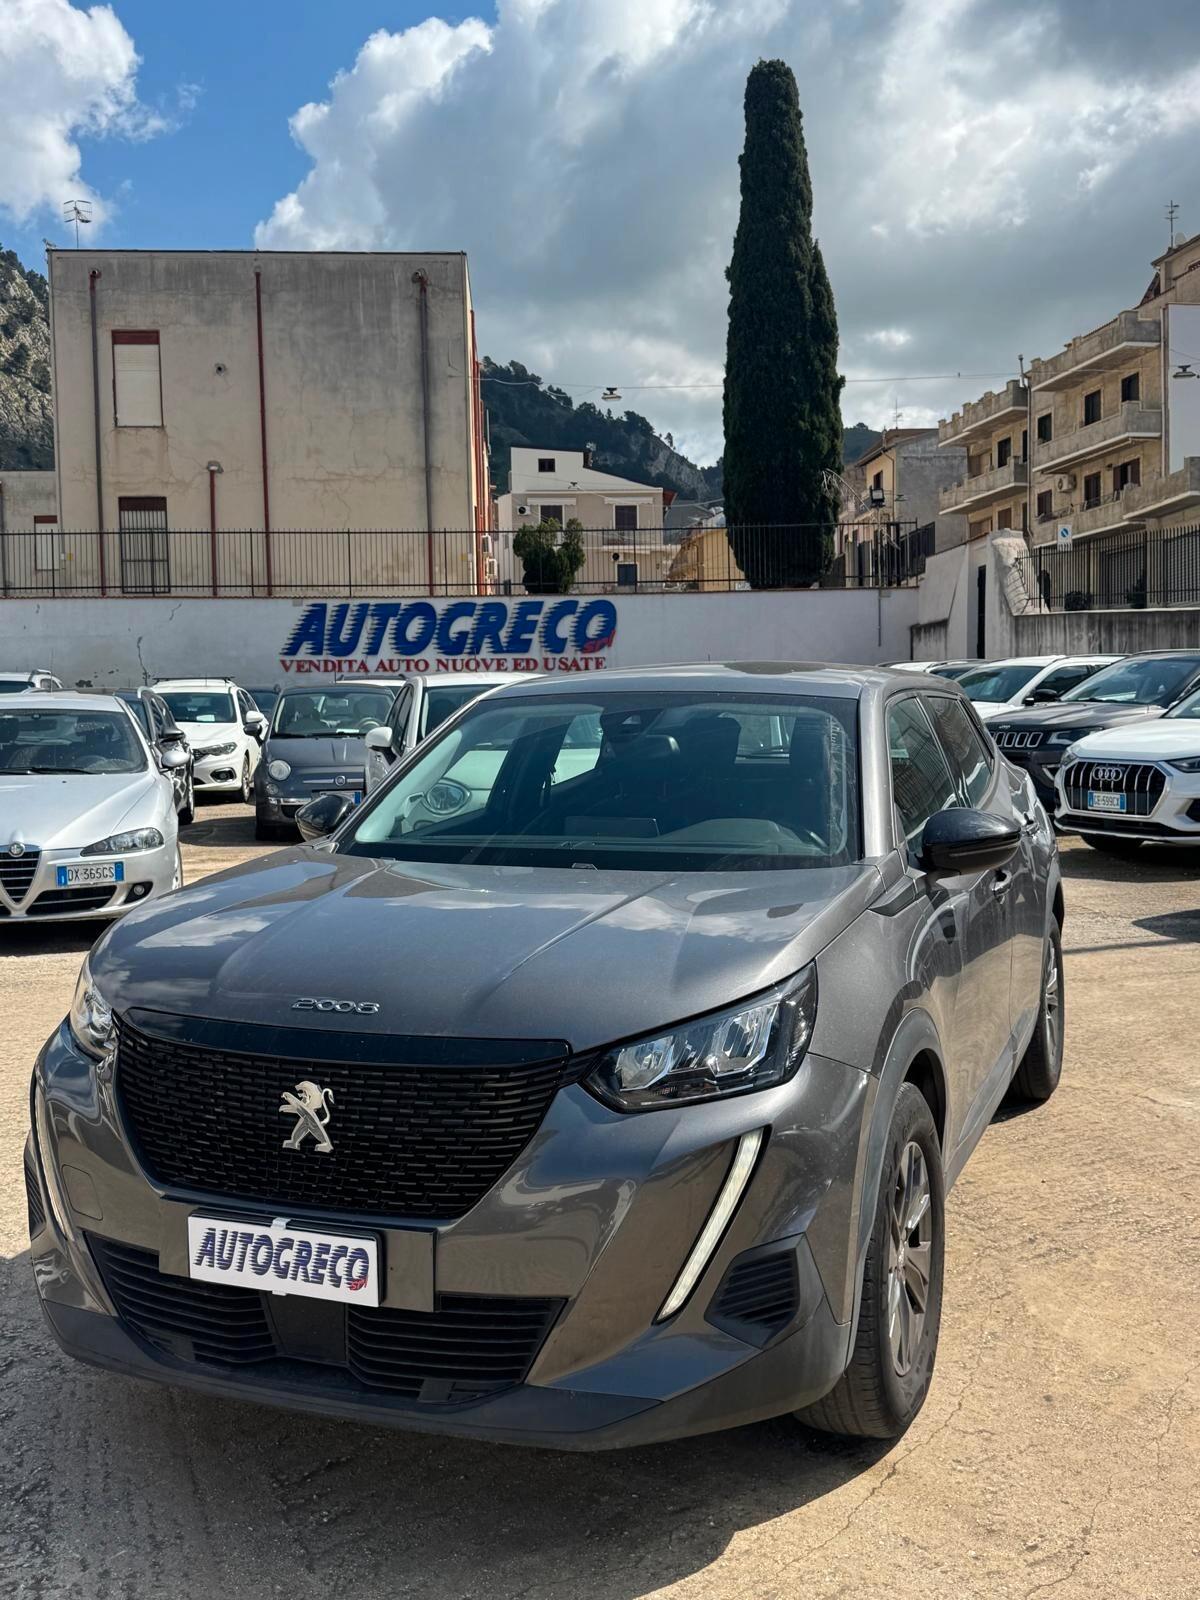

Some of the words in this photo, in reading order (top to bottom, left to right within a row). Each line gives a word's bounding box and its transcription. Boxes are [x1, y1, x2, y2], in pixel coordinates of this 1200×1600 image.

[279, 600, 617, 656] AUTOGRECO
[280, 659, 370, 673] VENDITA
[374, 658, 429, 673] AUTO
[436, 657, 507, 672] NUOVE
[511, 657, 539, 672] ED
[543, 656, 607, 673] USATE
[291, 998, 380, 1013] 2008
[193, 1227, 369, 1290] AUTOGRECO
